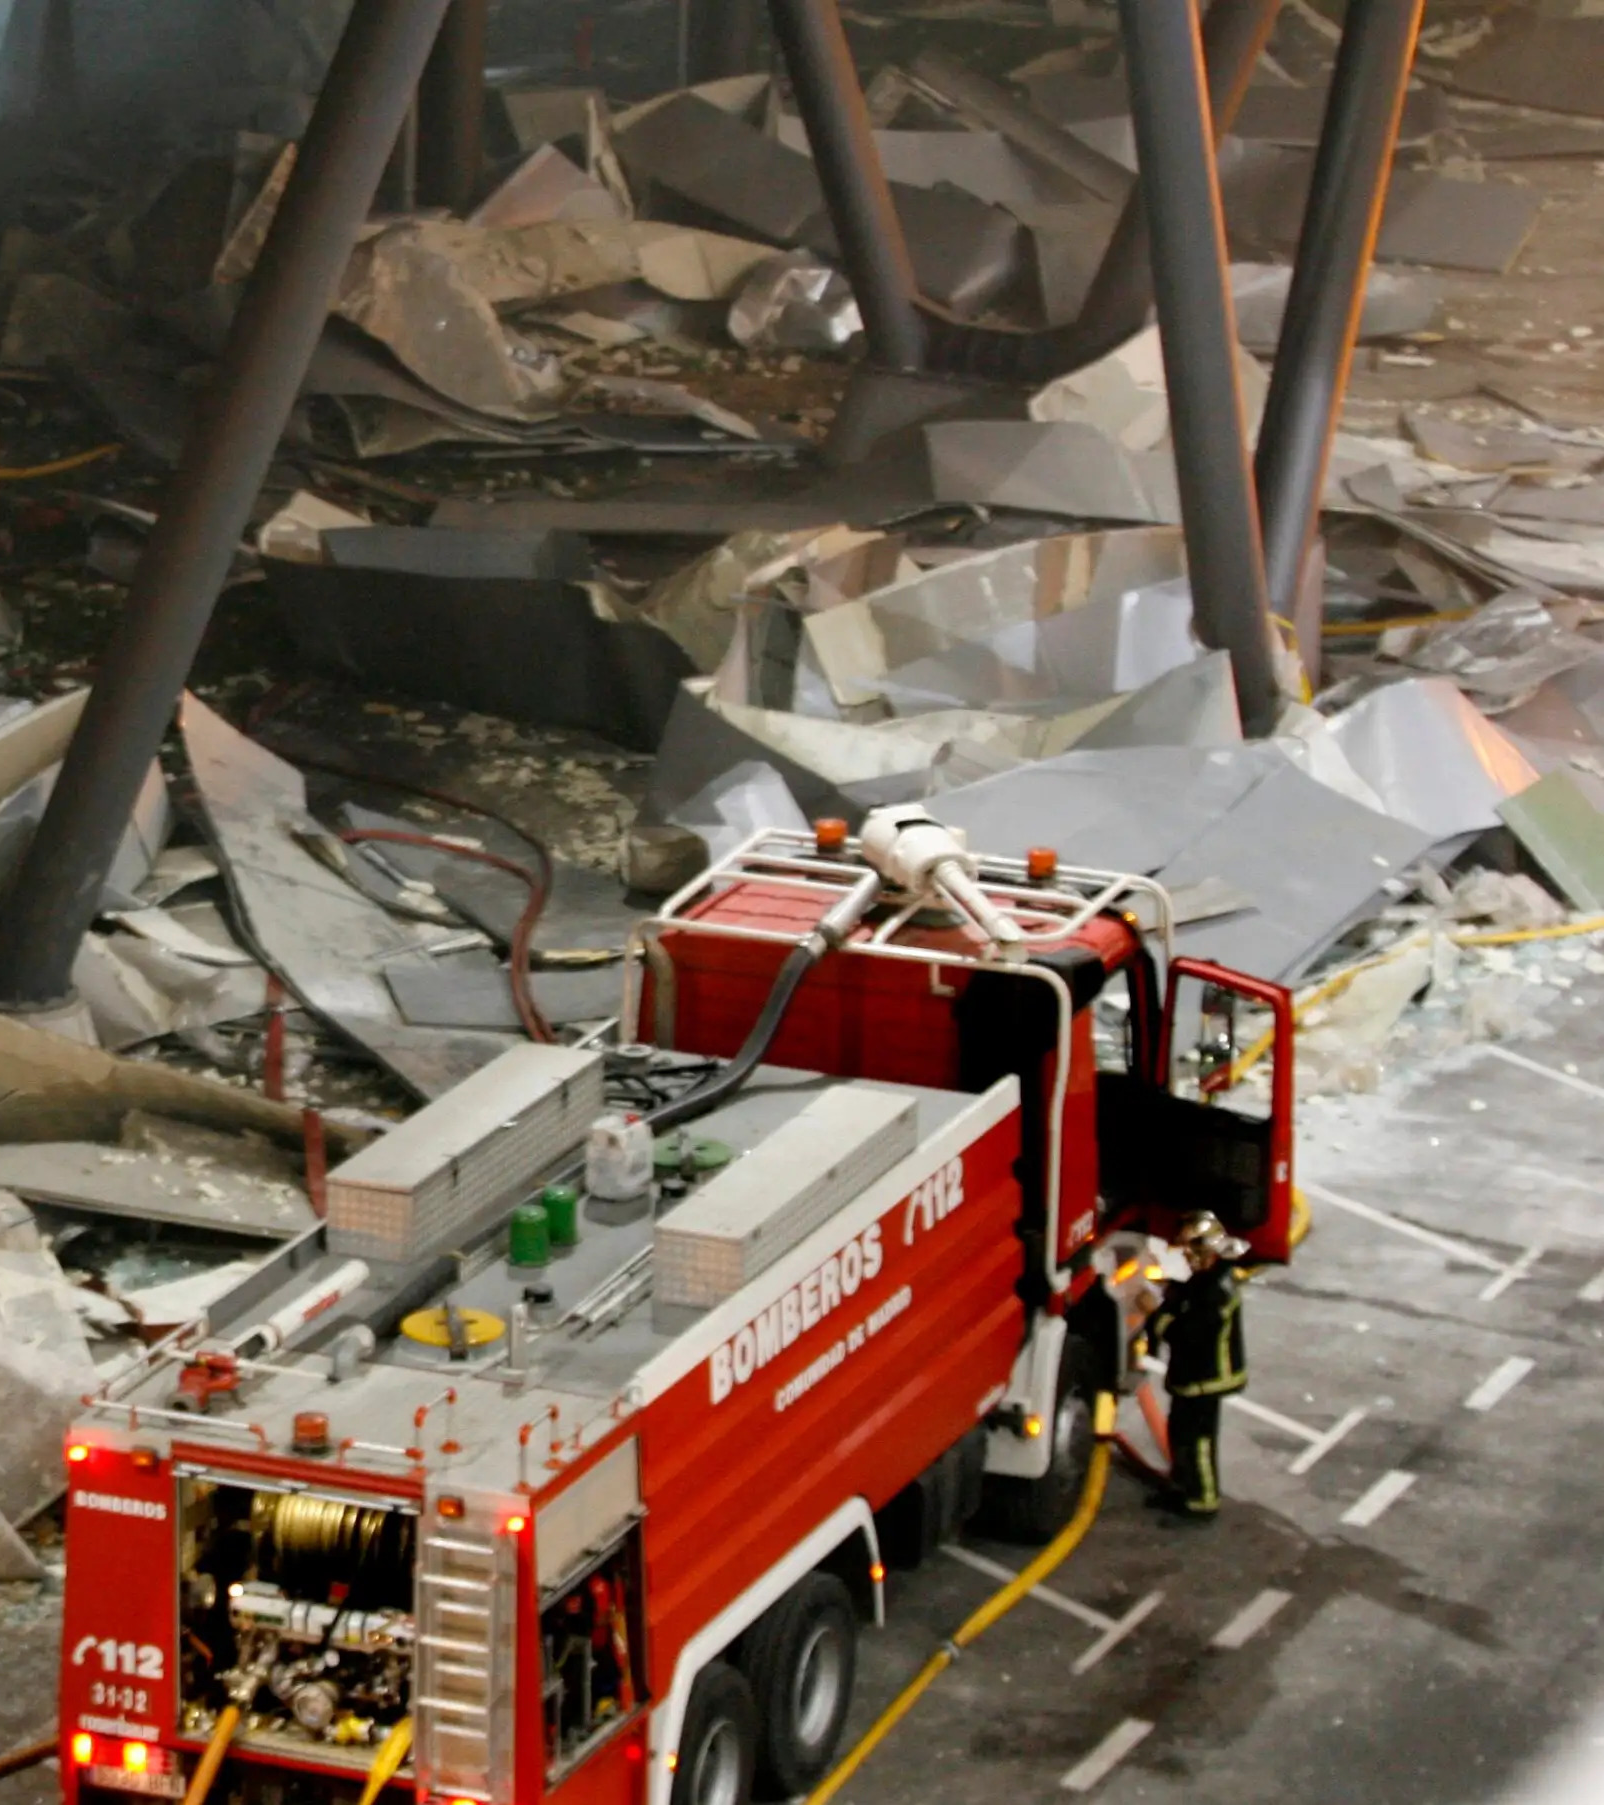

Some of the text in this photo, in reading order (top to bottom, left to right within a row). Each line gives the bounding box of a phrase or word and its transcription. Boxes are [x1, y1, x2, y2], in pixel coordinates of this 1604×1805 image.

[710, 1156, 964, 1405] BOMBEROS 112
[74, 1490, 167, 1520] BOMBEROS
[98, 1638, 164, 1680] 112
